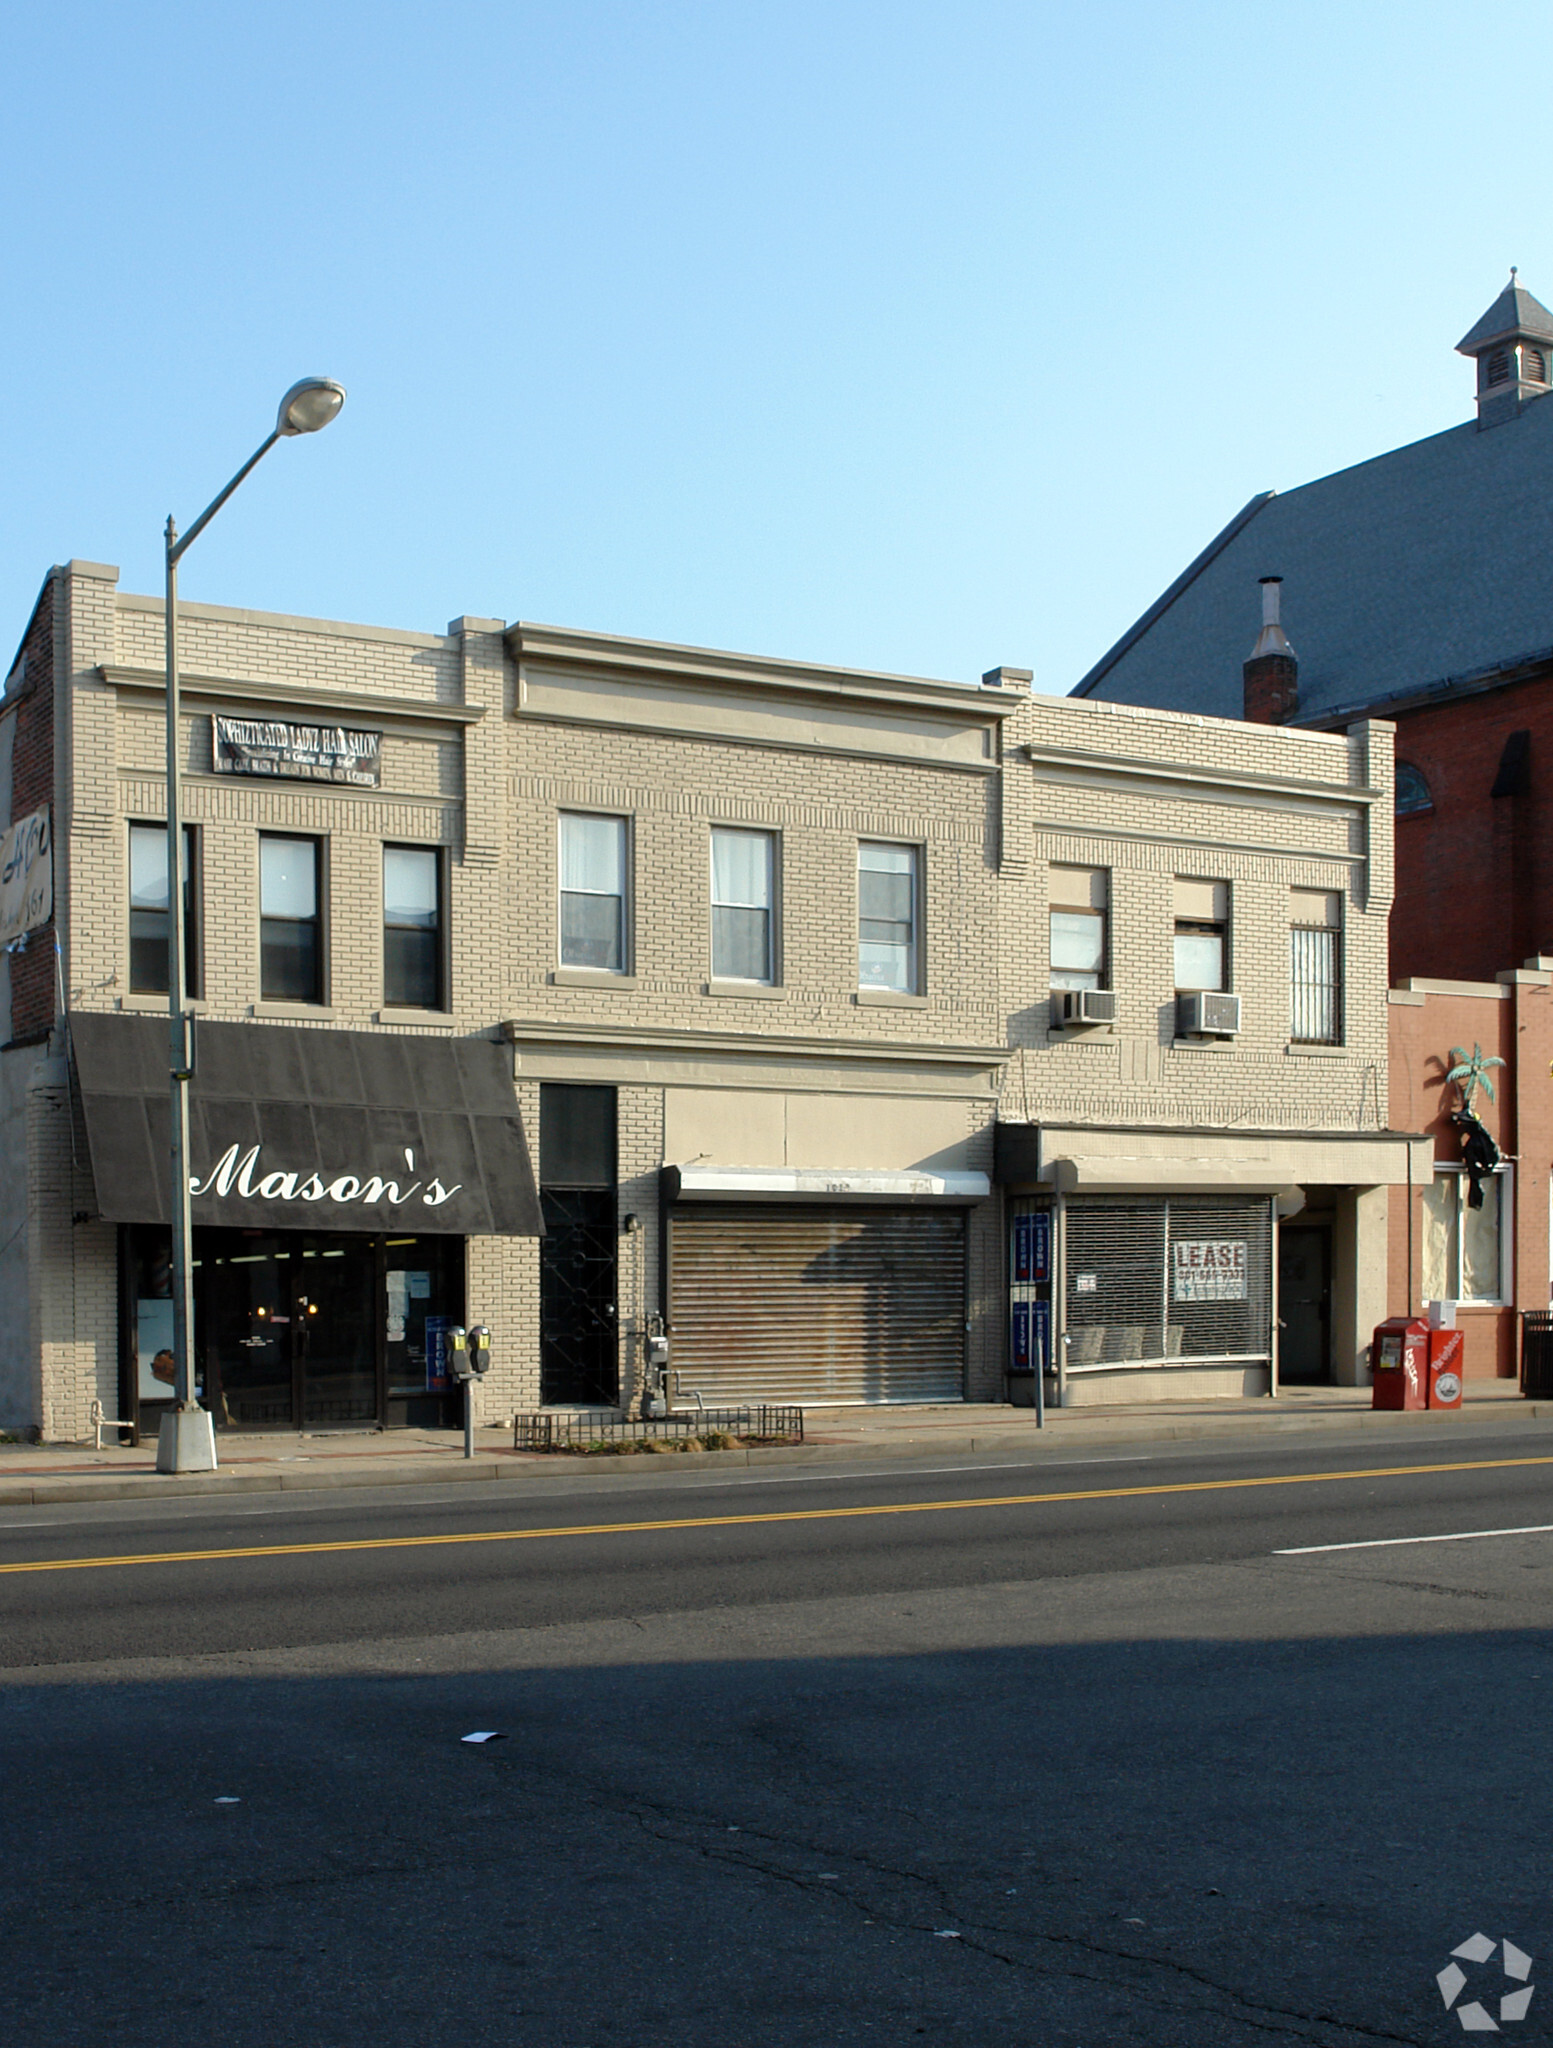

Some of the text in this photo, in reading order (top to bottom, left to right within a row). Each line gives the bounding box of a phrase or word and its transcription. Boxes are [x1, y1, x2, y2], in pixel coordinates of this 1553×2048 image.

[217, 716, 289, 747] SOPHIZTICATED
[348, 731, 379, 758] SALON
[189, 1143, 462, 1206] Mason's
[1178, 1246, 1244, 1267] LEASE
